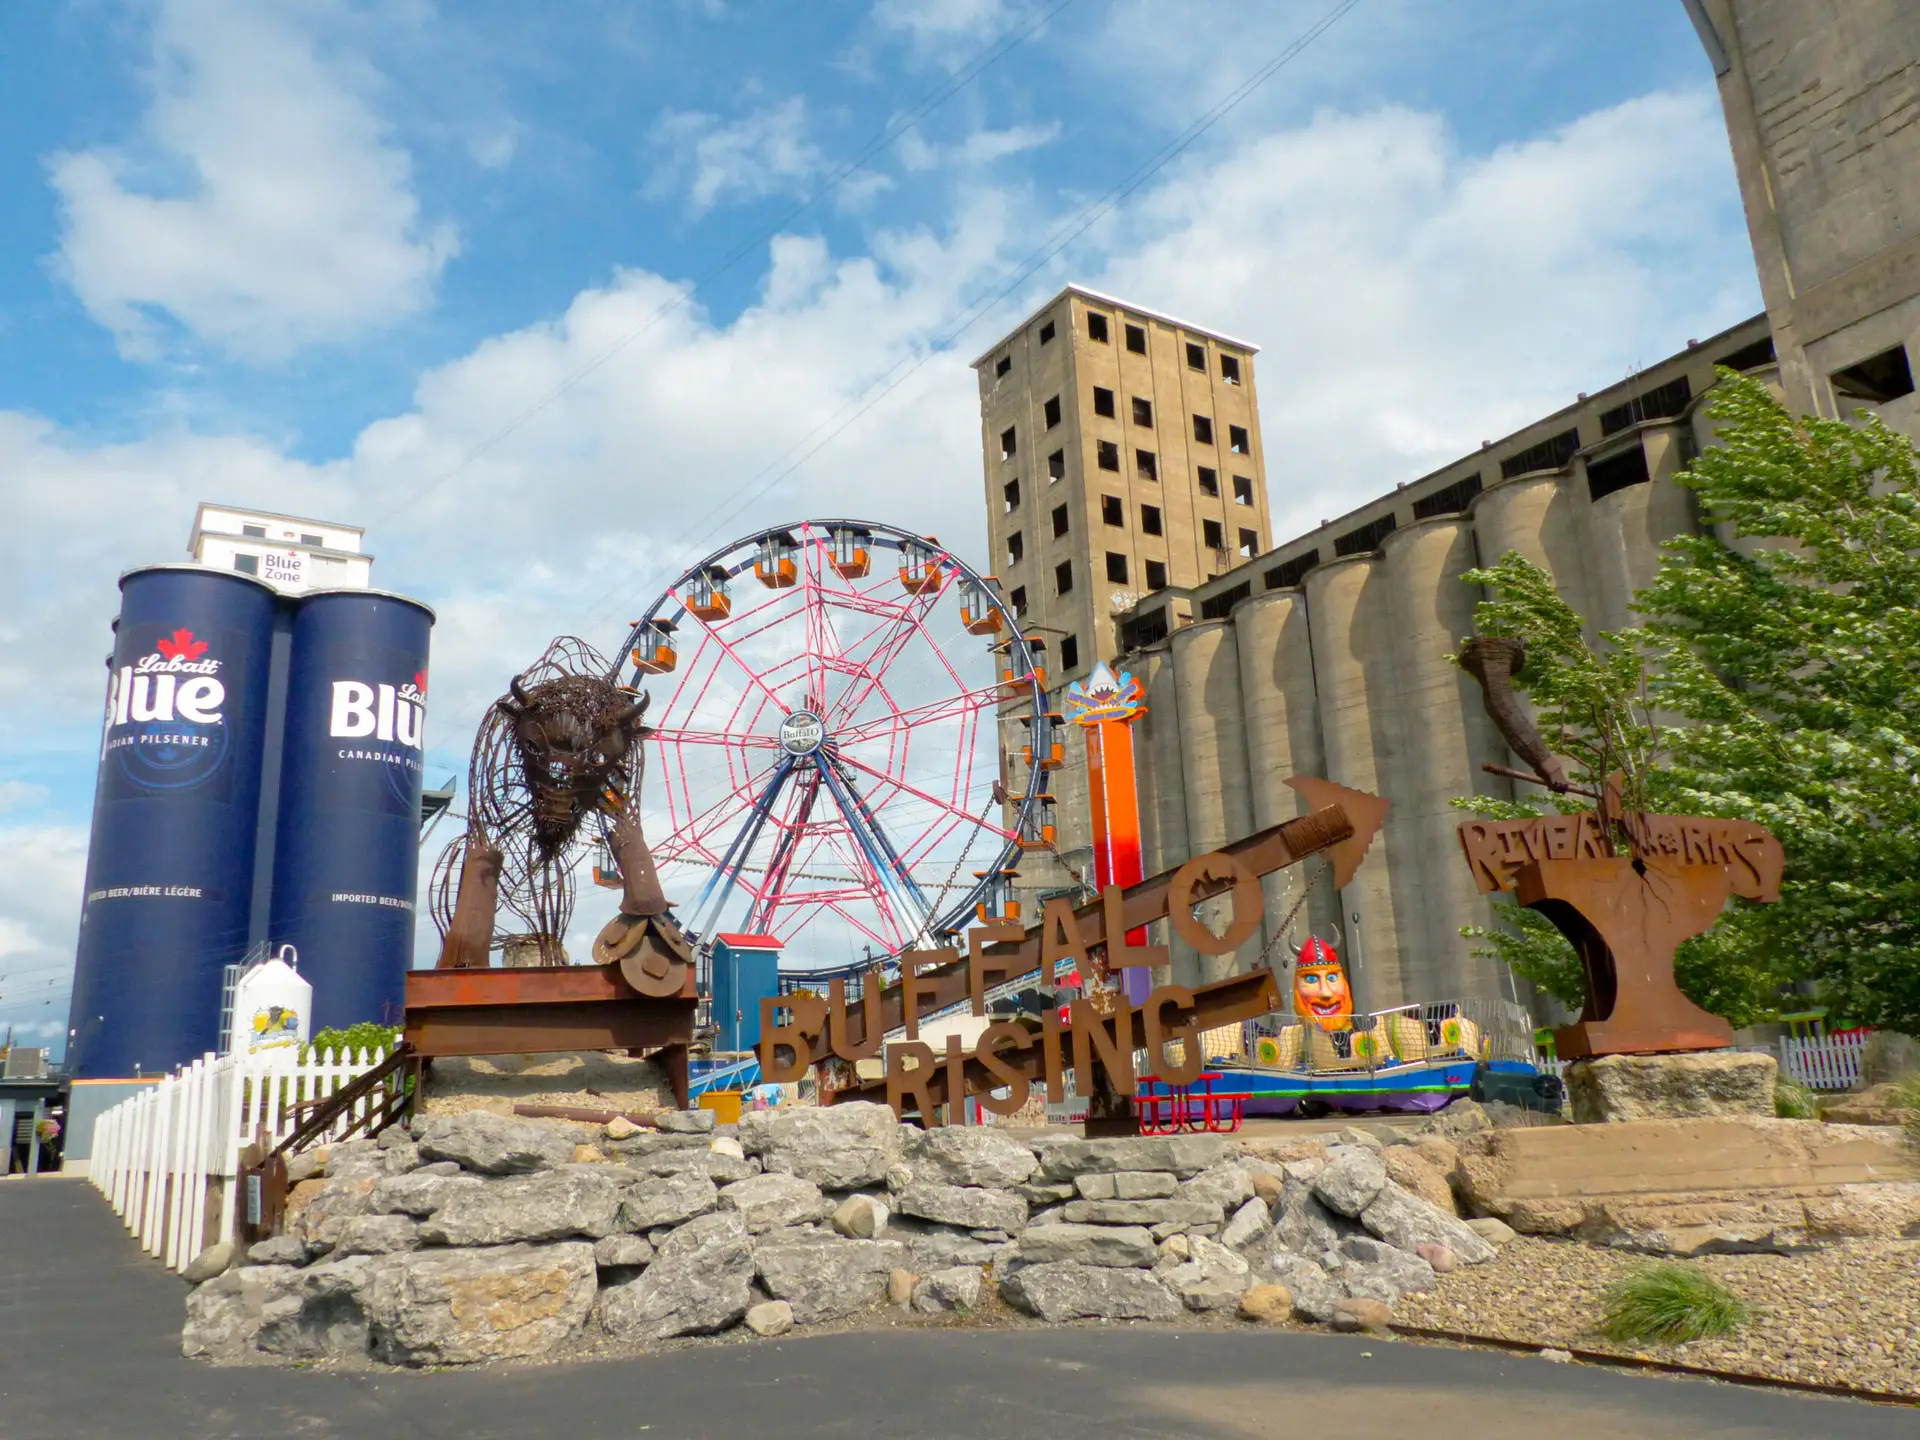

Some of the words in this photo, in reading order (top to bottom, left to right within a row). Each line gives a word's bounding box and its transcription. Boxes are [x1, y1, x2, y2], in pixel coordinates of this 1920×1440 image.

[265, 554, 302, 570] Blue
[265, 567, 301, 583] Zone
[134, 653, 219, 675] Labatt
[330, 680, 426, 751] Blu
[140, 734, 209, 746] PILSENER
[338, 749, 402, 765] CANADIAN
[165, 884, 203, 898] LÉGÈRE
[331, 893, 378, 905] IMPORTED
[759, 852, 1264, 1085] BUFFALO
[886, 984, 1203, 1130] RISING
